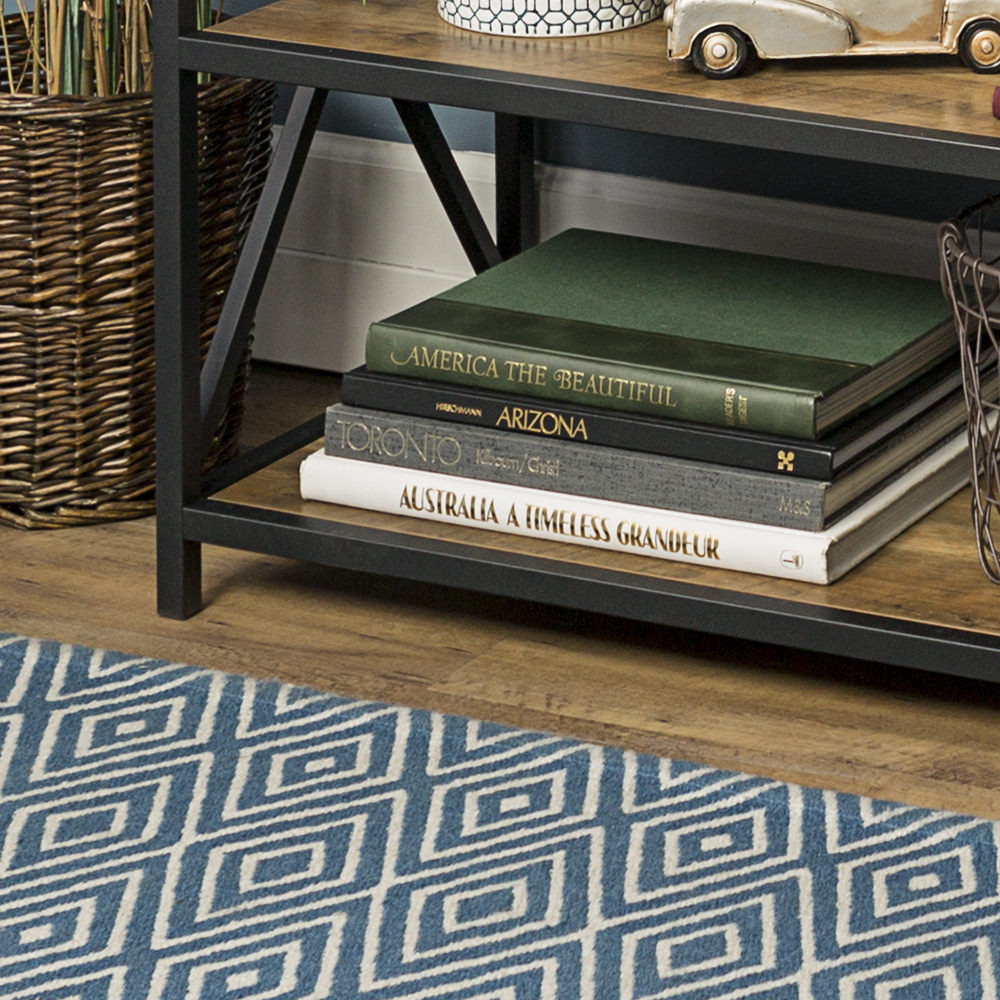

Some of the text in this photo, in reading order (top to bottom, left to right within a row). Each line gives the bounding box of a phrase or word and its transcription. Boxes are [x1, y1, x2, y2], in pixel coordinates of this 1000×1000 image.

[390, 346, 678, 408] AMERICA THE BEAUTIFUL
[337, 419, 462, 466] TORONTO
[495, 406, 588, 441] ARIZONA
[399, 484, 721, 561] AUSTRALIA A TIMELESS GRANDEUR
[779, 495, 811, 517] M&S
